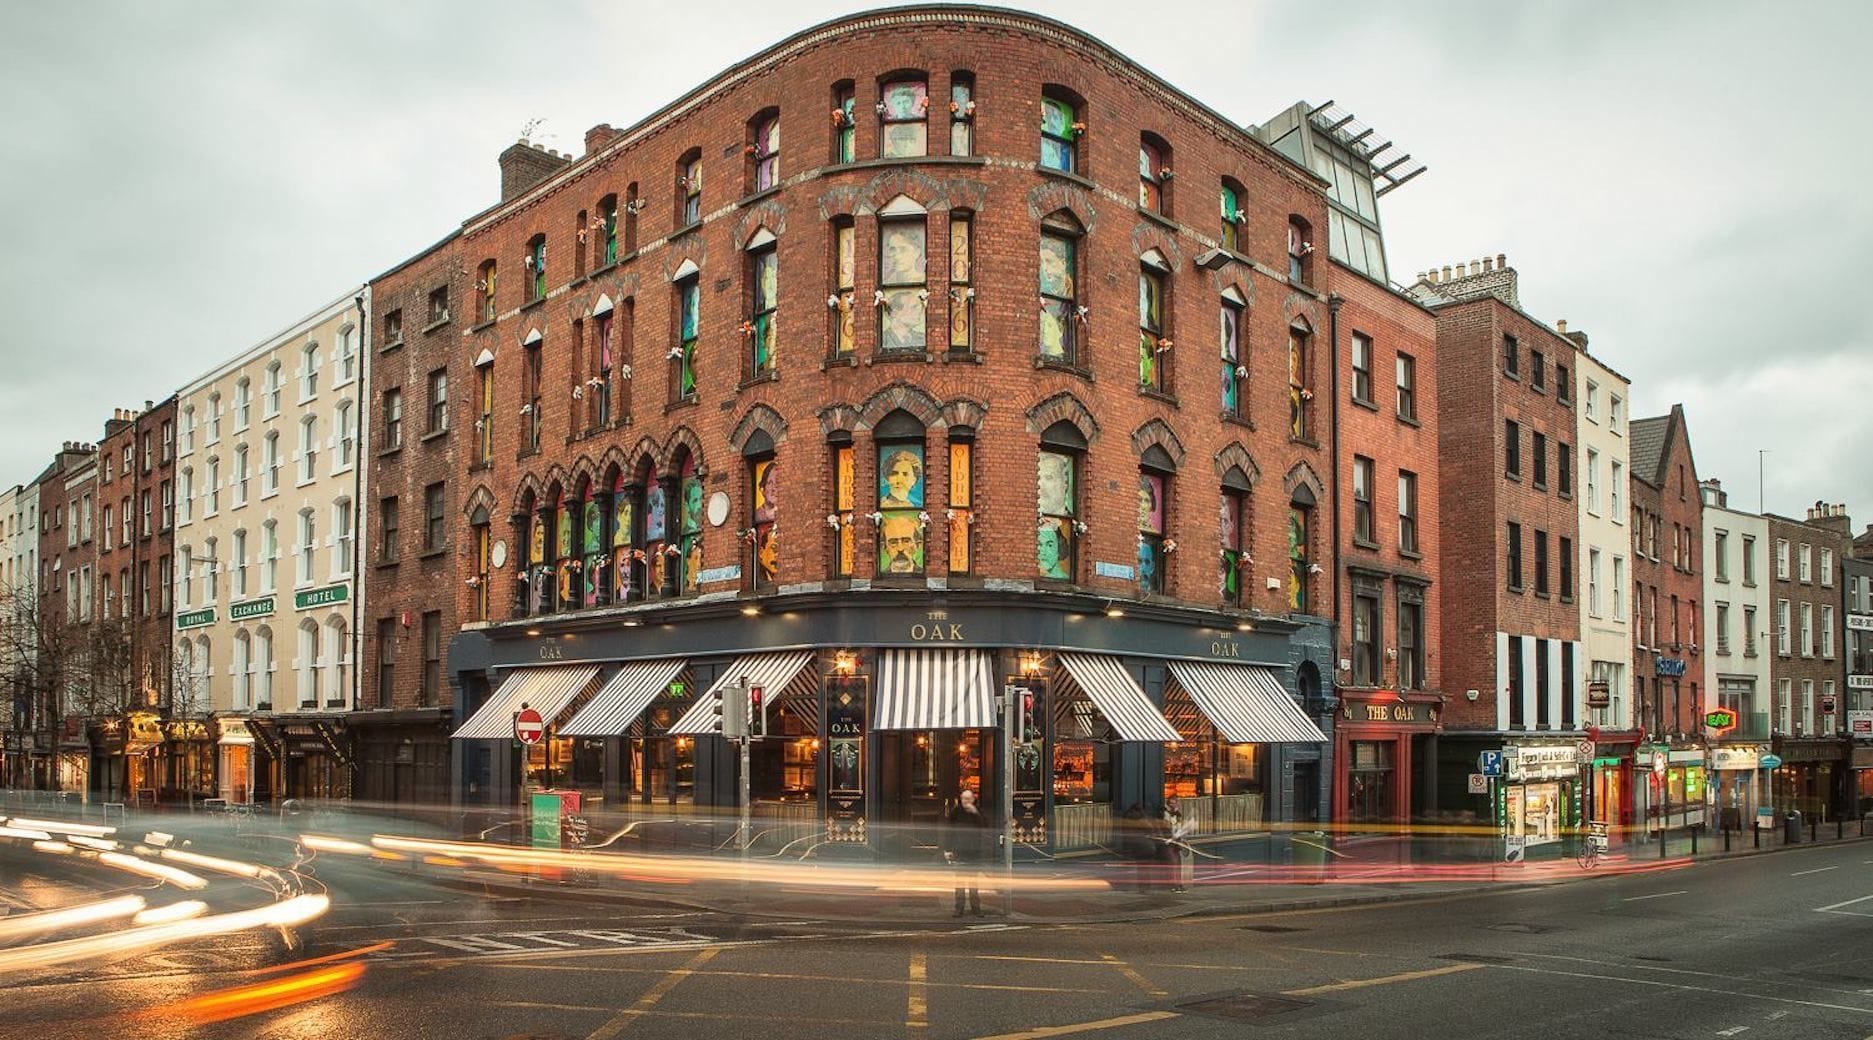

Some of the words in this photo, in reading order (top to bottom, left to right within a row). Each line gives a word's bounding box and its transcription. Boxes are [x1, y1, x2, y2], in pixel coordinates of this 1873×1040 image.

[233, 601, 272, 617] EXCHANGE
[307, 590, 336, 604] HOTEL
[926, 611, 948, 621] THE
[911, 624, 965, 640] OAK
[539, 646, 562, 659] OAK
[1211, 641, 1240, 658] OAK
[1366, 705, 1388, 720] THE
[1394, 705, 1415, 720] OAK
[831, 723, 861, 733] OAK
